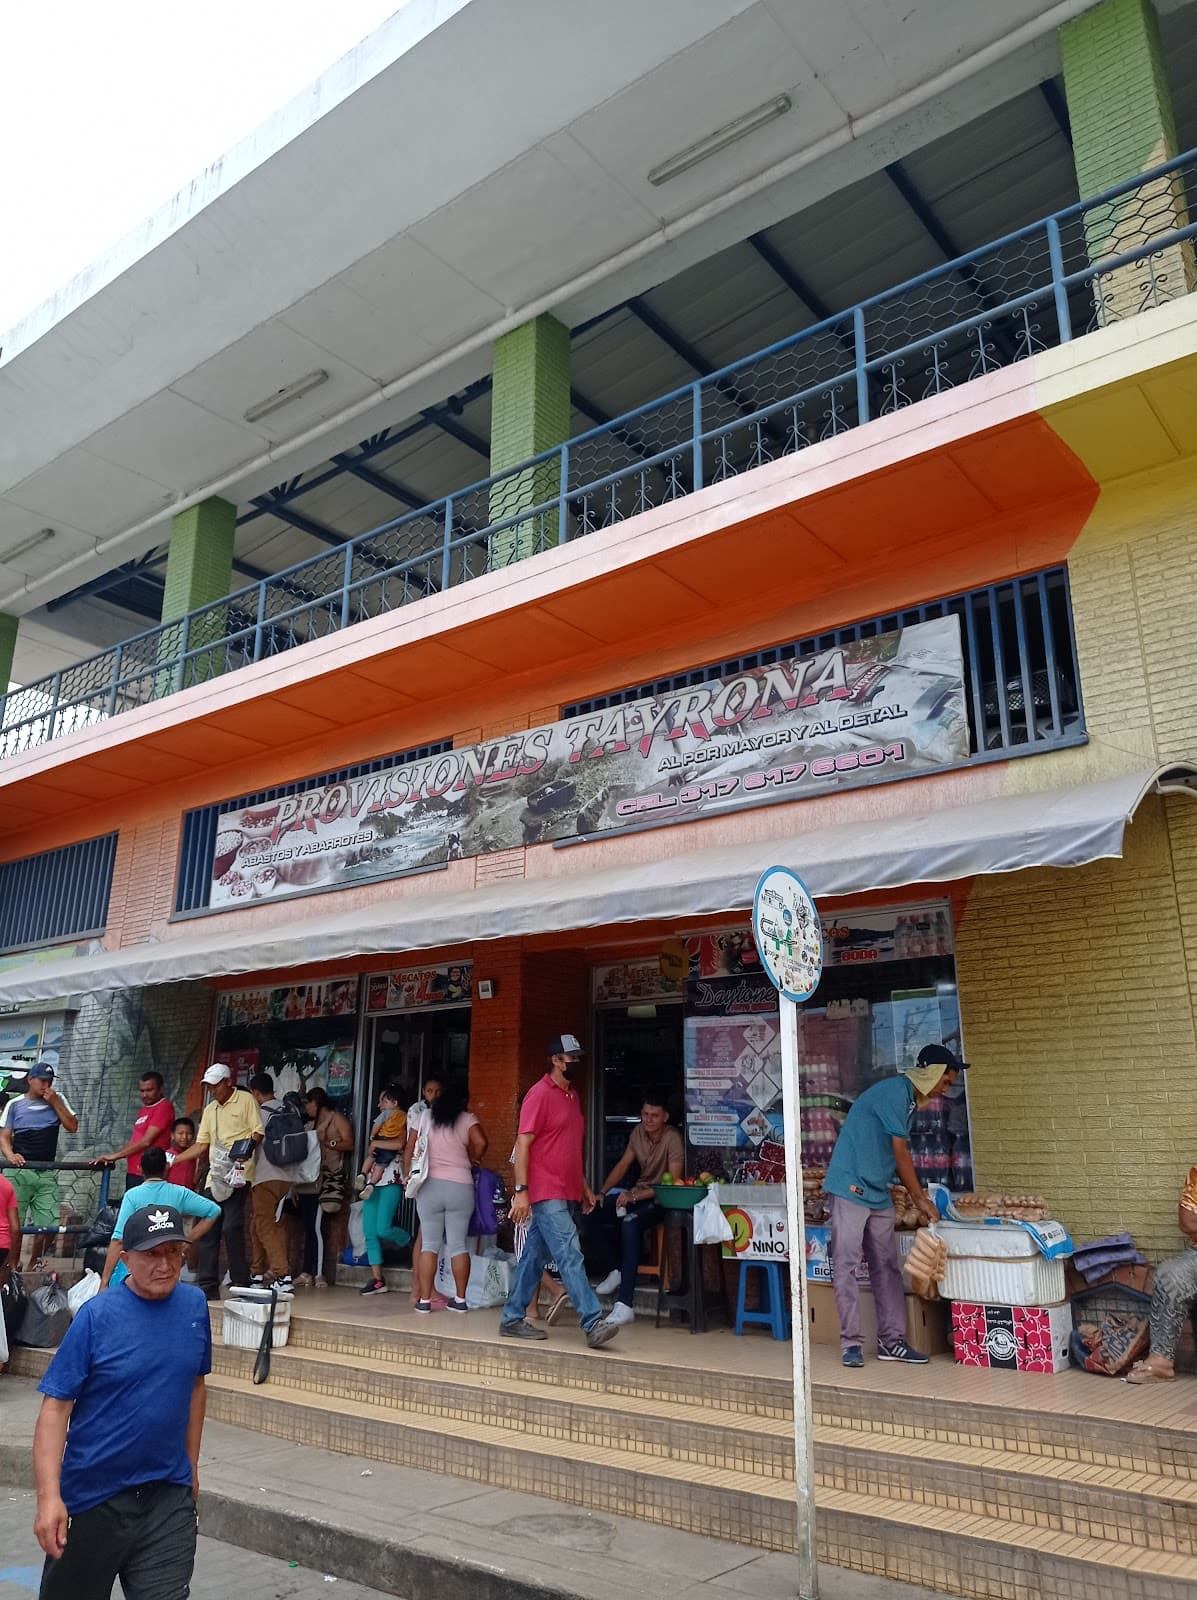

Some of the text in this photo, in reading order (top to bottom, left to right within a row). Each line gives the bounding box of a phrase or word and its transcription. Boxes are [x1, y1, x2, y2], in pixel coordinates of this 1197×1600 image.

[272, 651, 853, 843] PROVISIONES TAYRONA
[657, 704, 908, 772] AL POR MAYOR Y AL DETAL
[680, 777, 740, 804] 317
[744, 763, 807, 791] 817
[812, 743, 905, 777] 6601
[241, 848, 293, 868] ABASTOS
[148, 1221, 174, 1232] adidas
[752, 1241, 785, 1254] NINO
